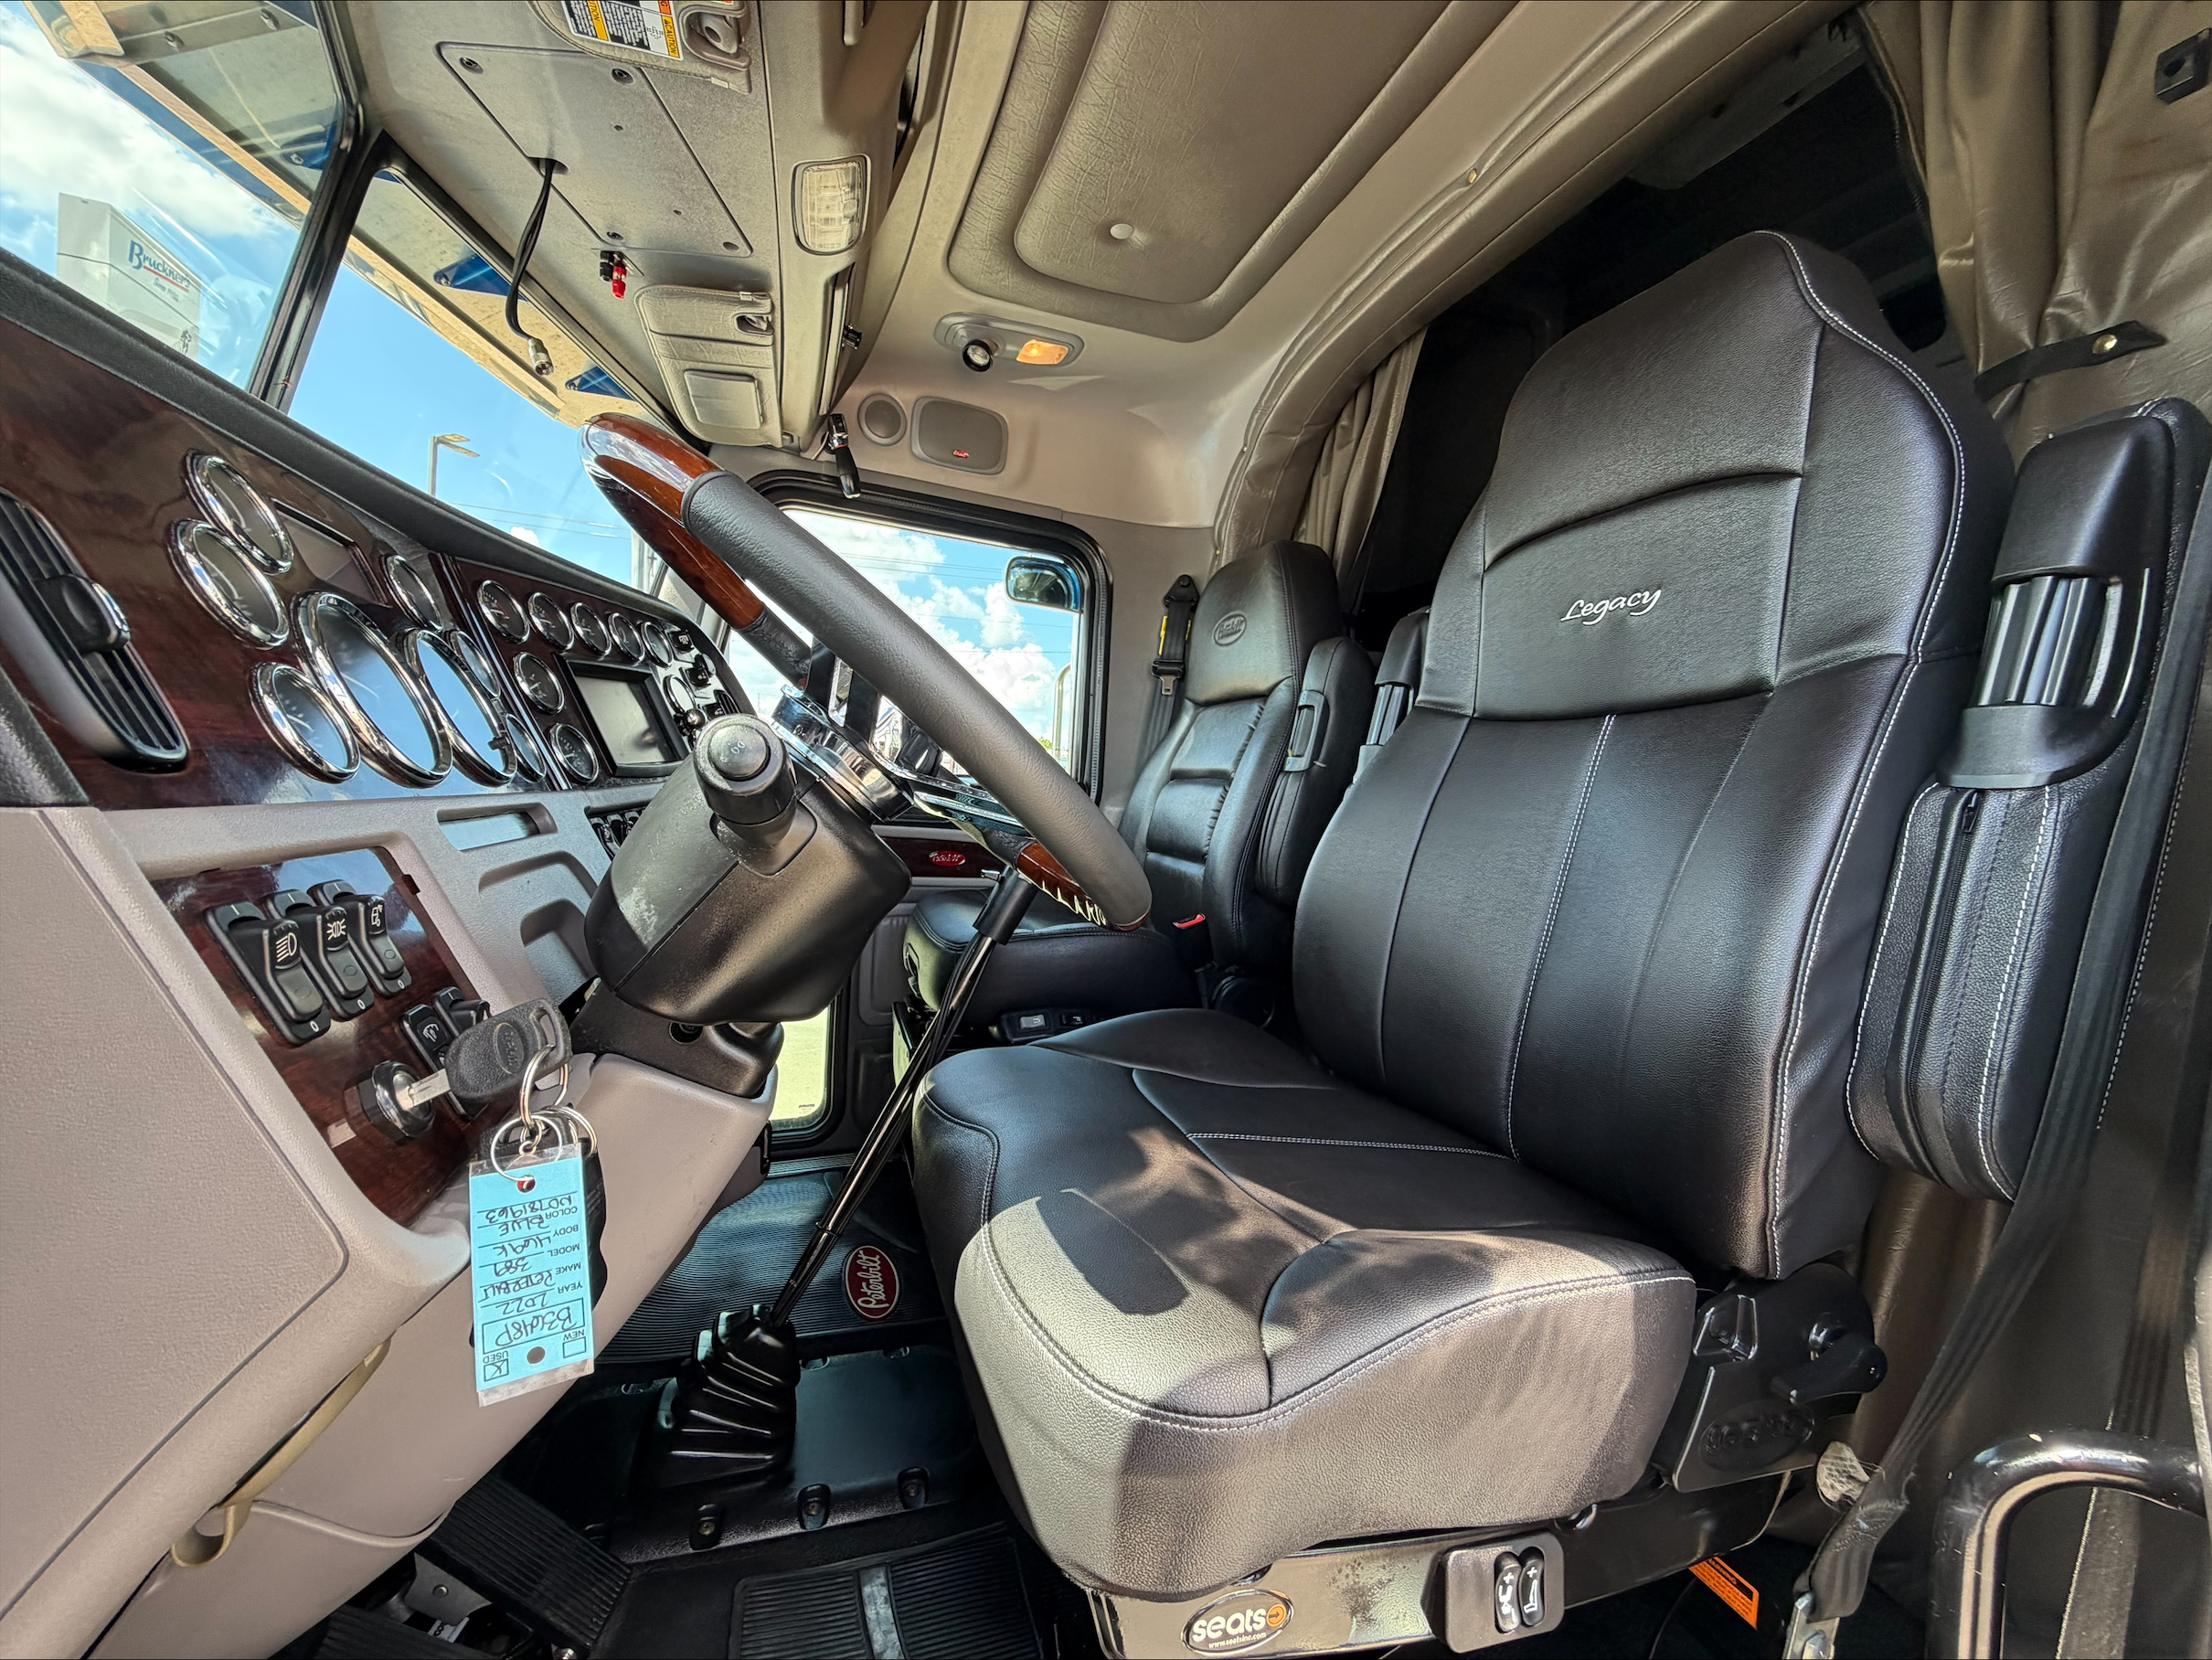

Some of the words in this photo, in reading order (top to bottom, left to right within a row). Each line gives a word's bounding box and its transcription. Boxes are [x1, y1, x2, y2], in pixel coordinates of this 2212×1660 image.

[665, 24, 677, 55] CAUTION
[1560, 589, 1662, 625] Legacy
[545, 1206, 578, 1219] COLOR
[498, 1214, 550, 1237] BLUE
[553, 1224, 579, 1238] BODY
[548, 1243, 580, 1257] MODEL
[494, 1257, 532, 1277] 389
[556, 1261, 581, 1275] MAKE
[558, 1281, 583, 1293] YEAR
[856, 1250, 889, 1308] Peterbilt
[495, 1293, 548, 1315] 2022
[563, 1329, 585, 1341] NEW
[483, 1350, 509, 1364] USED
[1192, 1608, 1267, 1643] seats
